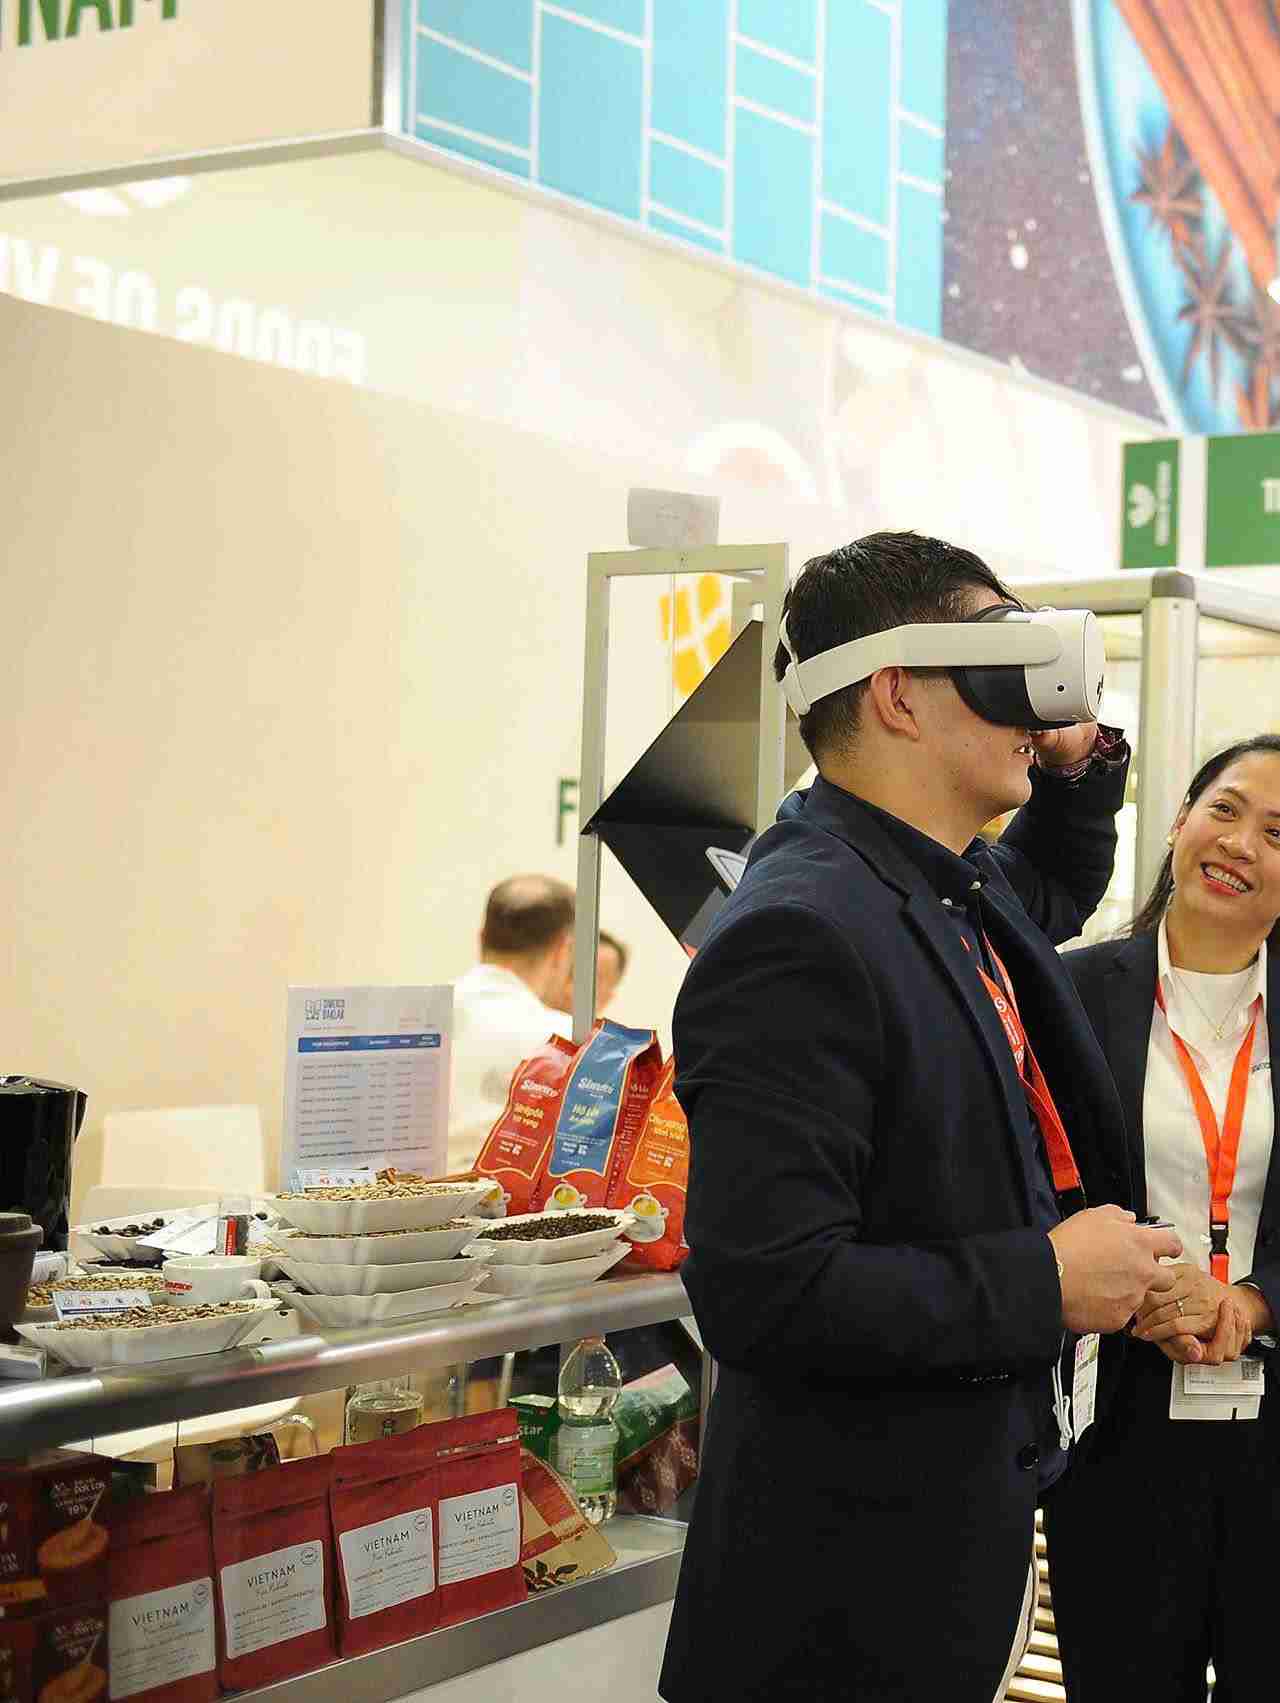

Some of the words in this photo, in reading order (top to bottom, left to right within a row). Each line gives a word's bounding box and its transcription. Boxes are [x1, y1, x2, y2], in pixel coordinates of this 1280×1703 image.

[454, 1503, 499, 1522] VIETNAM
[363, 1530, 410, 1552] VIETNAM
[247, 1564, 296, 1588] VIETNAM
[131, 1601, 190, 1627] VIETNAM
